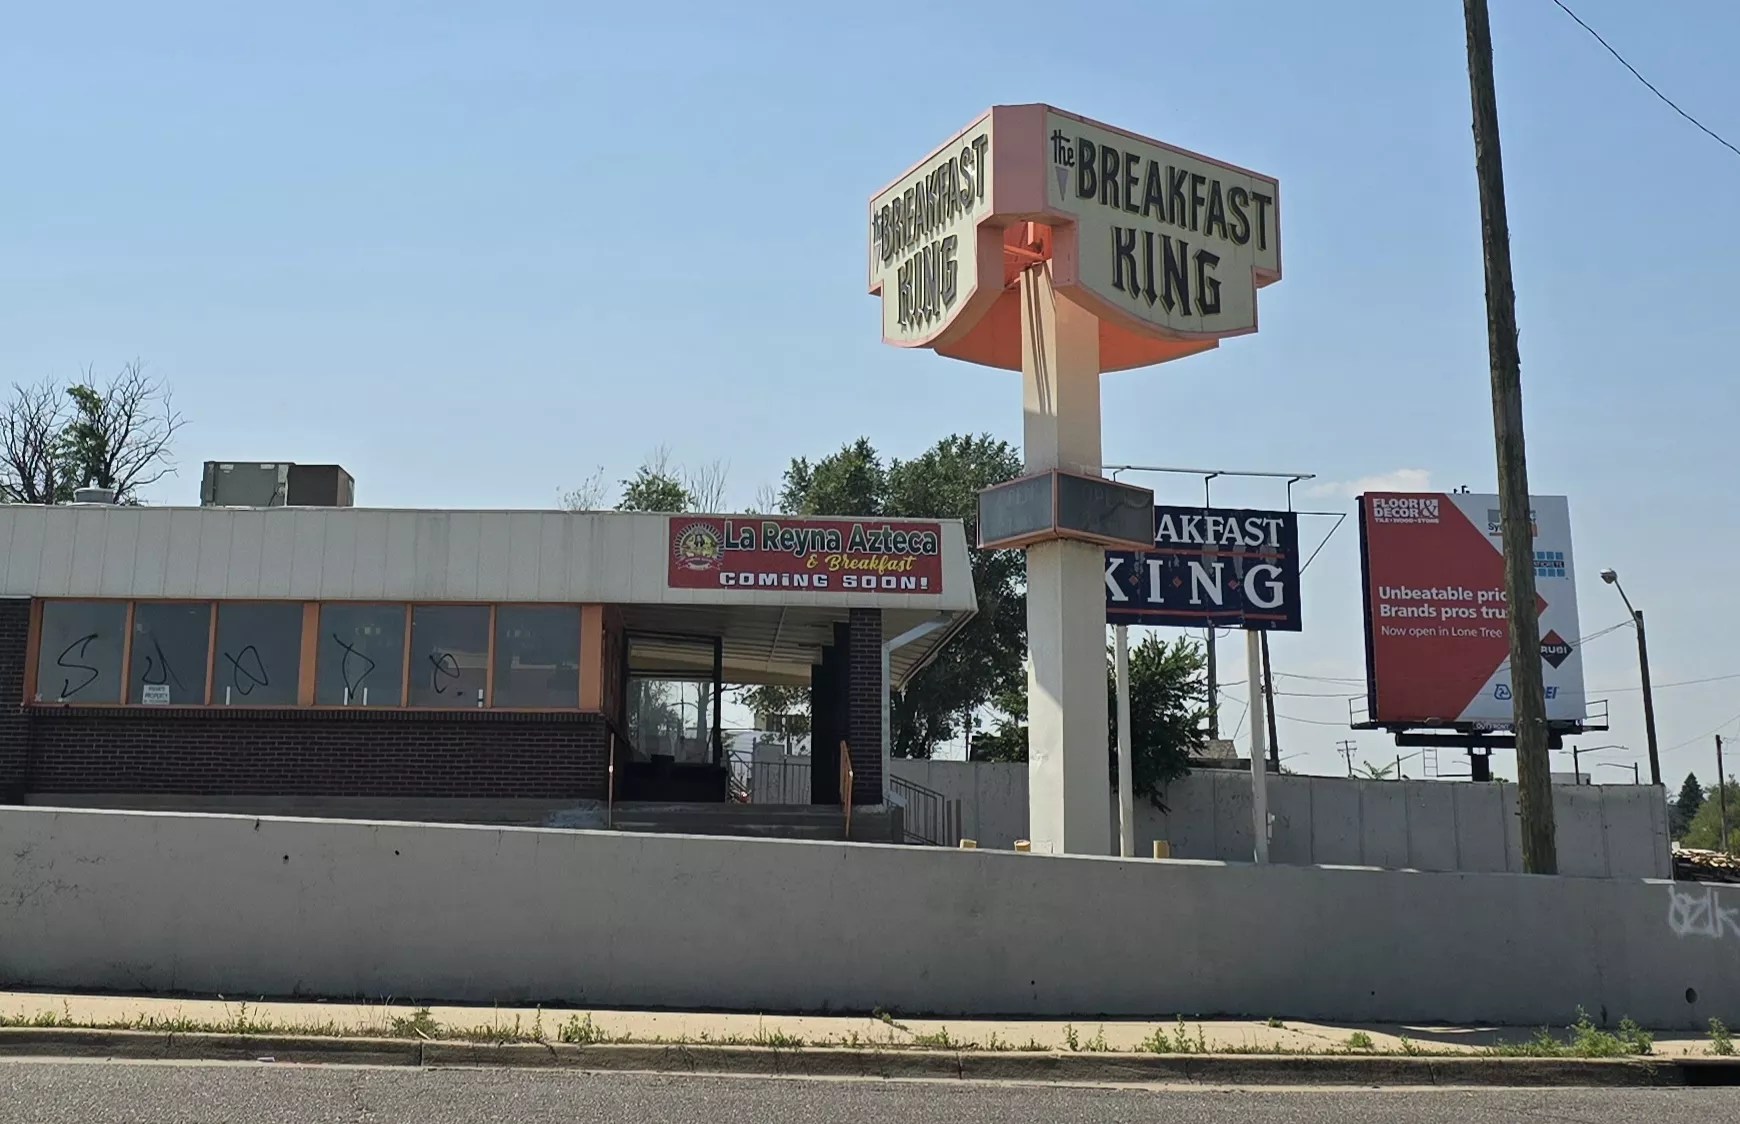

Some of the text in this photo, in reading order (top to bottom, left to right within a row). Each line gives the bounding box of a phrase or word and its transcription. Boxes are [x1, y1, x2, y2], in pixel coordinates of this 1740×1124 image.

[882, 133, 988, 264] BREAKFAST
[1051, 129, 1272, 252] the BREAKFAST
[897, 234, 958, 327] KING
[1111, 225, 1222, 317] KING
[1373, 498, 1419, 508] FLOOR
[723, 521, 939, 557] La Reyna Azteca
[1155, 514, 1284, 548] AKFAST
[806, 554, 915, 575] & Breakfast
[843, 574, 929, 590] SOON!
[1378, 586, 1508, 604] Unbeatable pric
[1380, 603, 1509, 621] Brands pros tru
[1381, 626, 1503, 638] Now open in Lone Tree
[1540, 646, 1567, 654] RUBI
